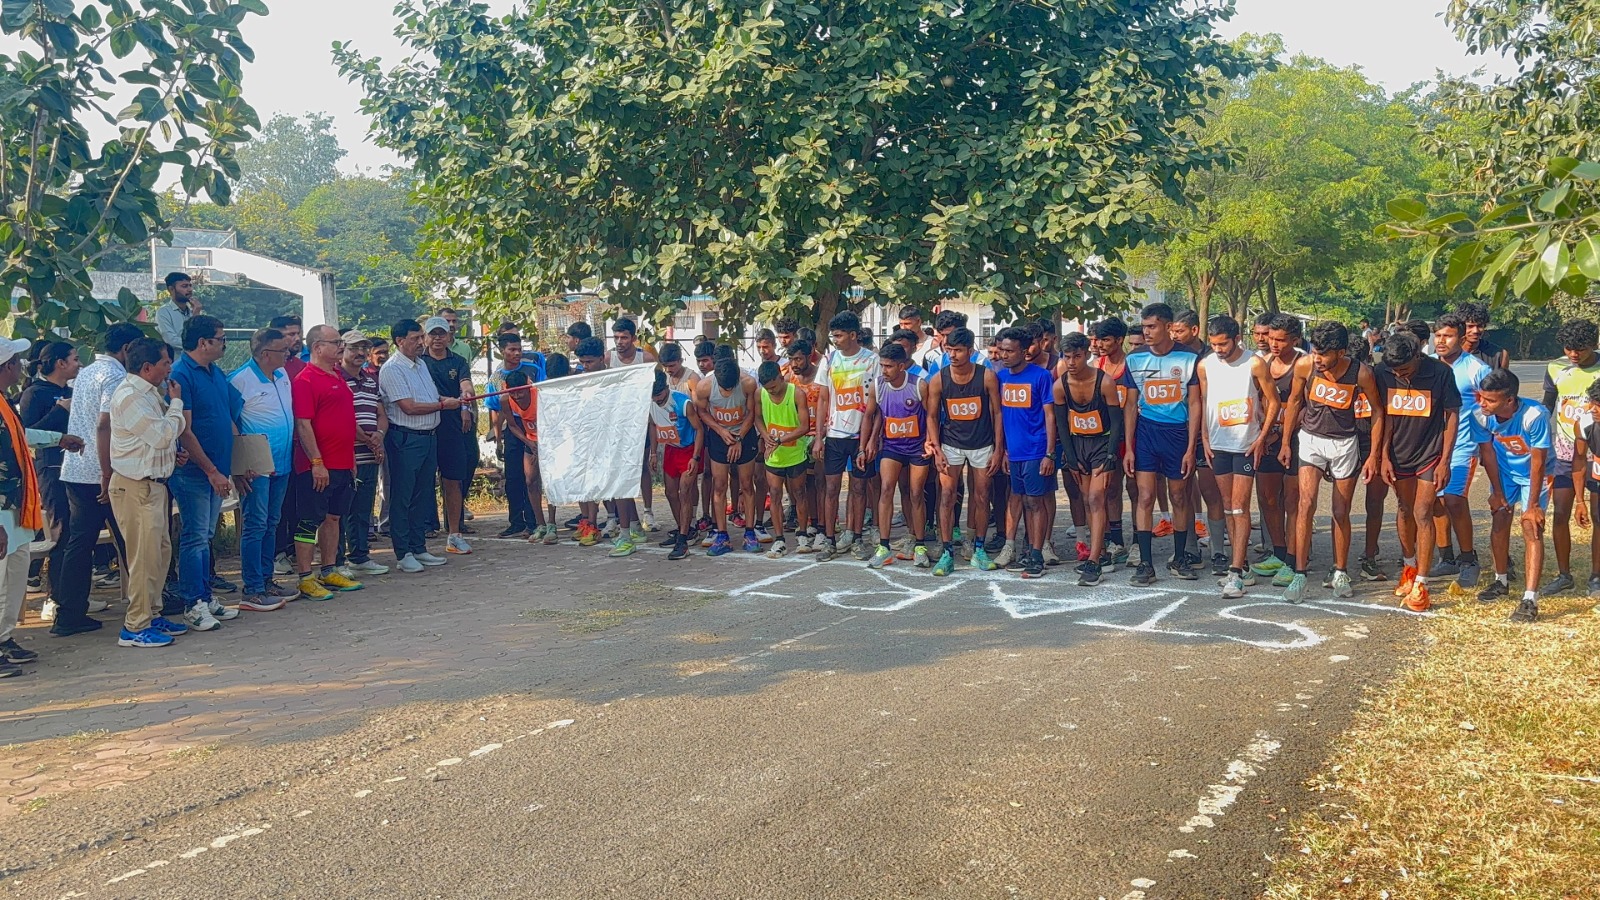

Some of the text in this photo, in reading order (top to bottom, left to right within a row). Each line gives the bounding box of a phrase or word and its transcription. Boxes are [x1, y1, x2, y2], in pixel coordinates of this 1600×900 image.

[837, 391, 861, 406] 026
[1004, 388, 1027, 402] 019
[1147, 384, 1177, 399] 057
[1315, 383, 1348, 404] 022
[950, 402, 978, 416] 039
[1354, 399, 1372, 413] 21
[1391, 394, 1426, 411] 020
[716, 412, 740, 422] 004
[1220, 401, 1249, 421] 052
[889, 421, 914, 434] 047
[1073, 416, 1098, 430] 038
